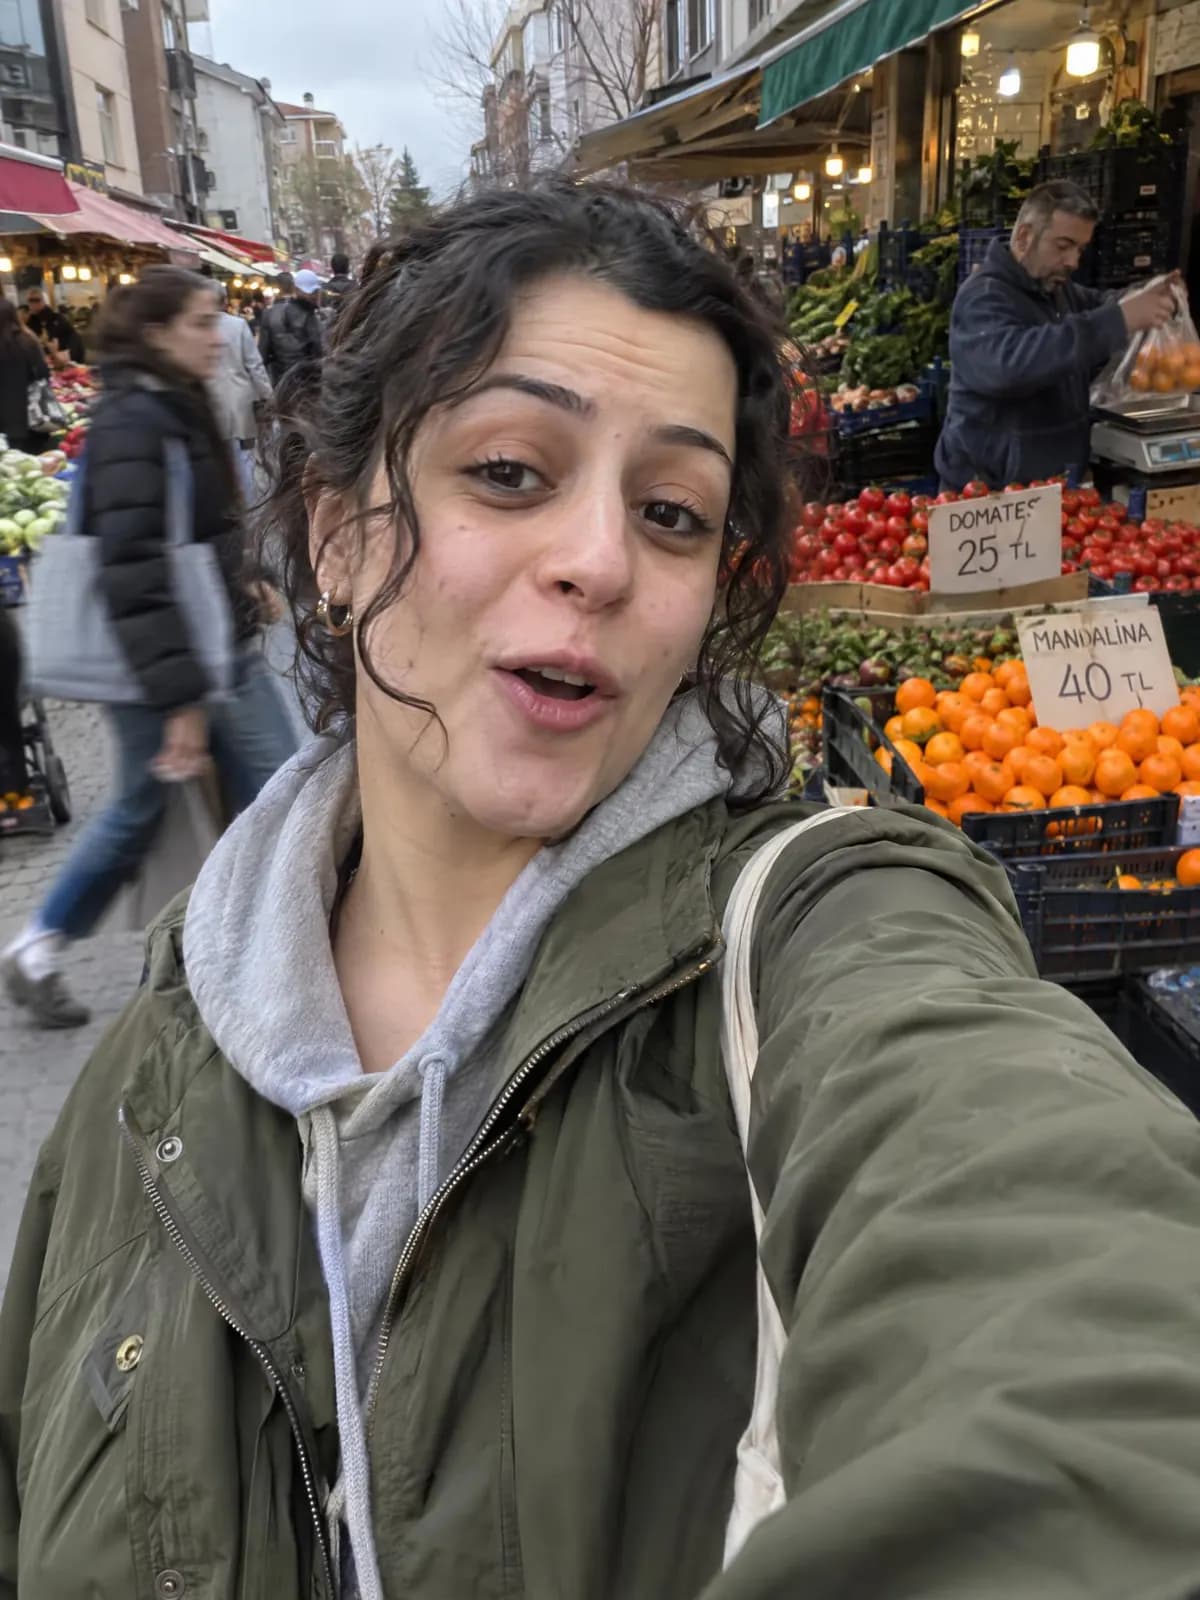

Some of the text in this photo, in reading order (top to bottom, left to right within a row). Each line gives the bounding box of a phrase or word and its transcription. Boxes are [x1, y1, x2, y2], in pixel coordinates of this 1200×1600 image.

[958, 535, 1037, 576] 25 TL
[1058, 662, 1153, 704] 40 TL
